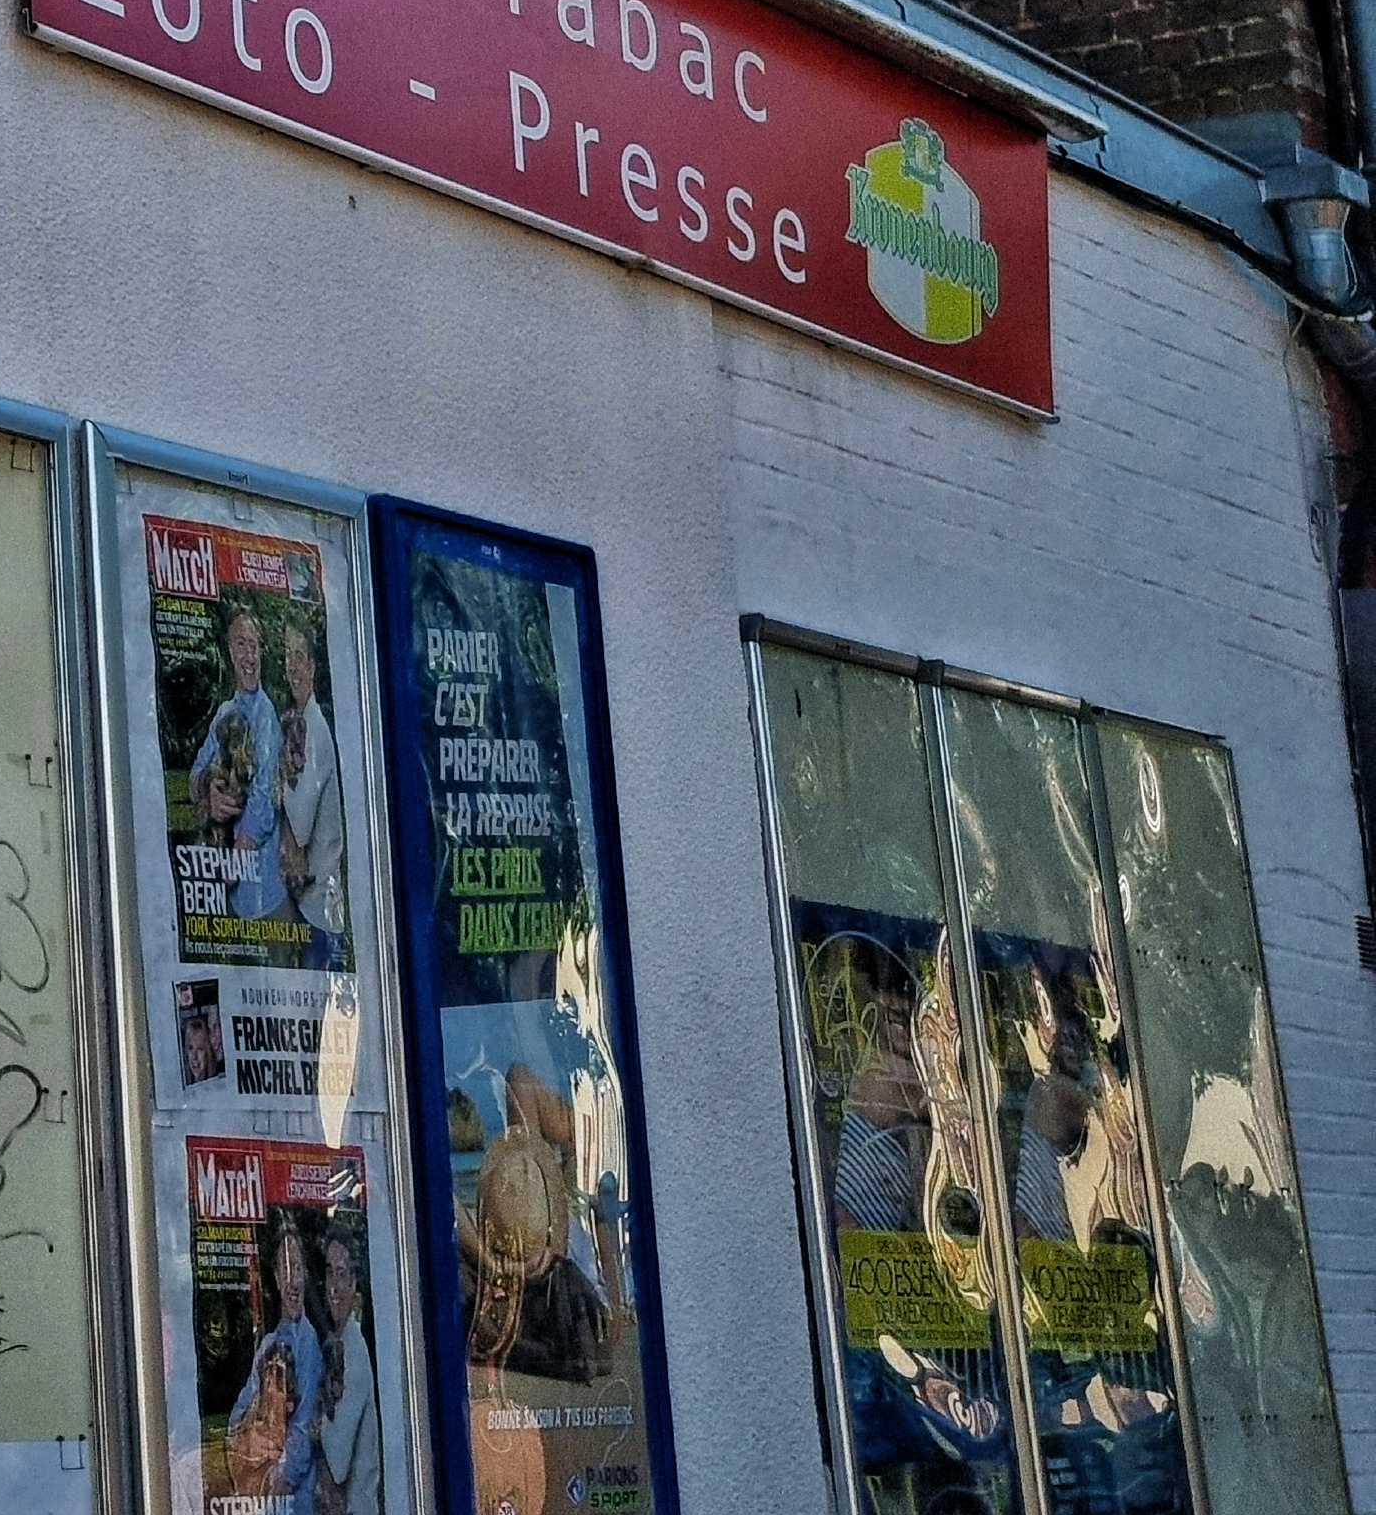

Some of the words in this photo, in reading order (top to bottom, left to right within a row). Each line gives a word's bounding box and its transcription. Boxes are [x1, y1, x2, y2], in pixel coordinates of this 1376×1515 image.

[509, 70, 808, 285] Presse
[846, 165, 997, 314] Kronenbourg
[151, 529, 217, 597] MATCH
[427, 627, 502, 682] PARIER,
[434, 681, 489, 727] C'EST
[439, 732, 541, 783] PRÉPARER
[446, 792, 472, 836] LA
[476, 793, 551, 837] REPRISE
[175, 841, 262, 883] STÉPHANE
[453, 848, 486, 892] LES
[182, 880, 228, 916] BERN
[460, 902, 516, 950] DANS
[231, 1015, 297, 1053] FRANCE
[236, 1059, 302, 1095] MICHEL
[196, 1152, 265, 1218] MATCH
[850, 1257, 893, 1297] 400
[590, 1490, 638, 1507] SPORT
